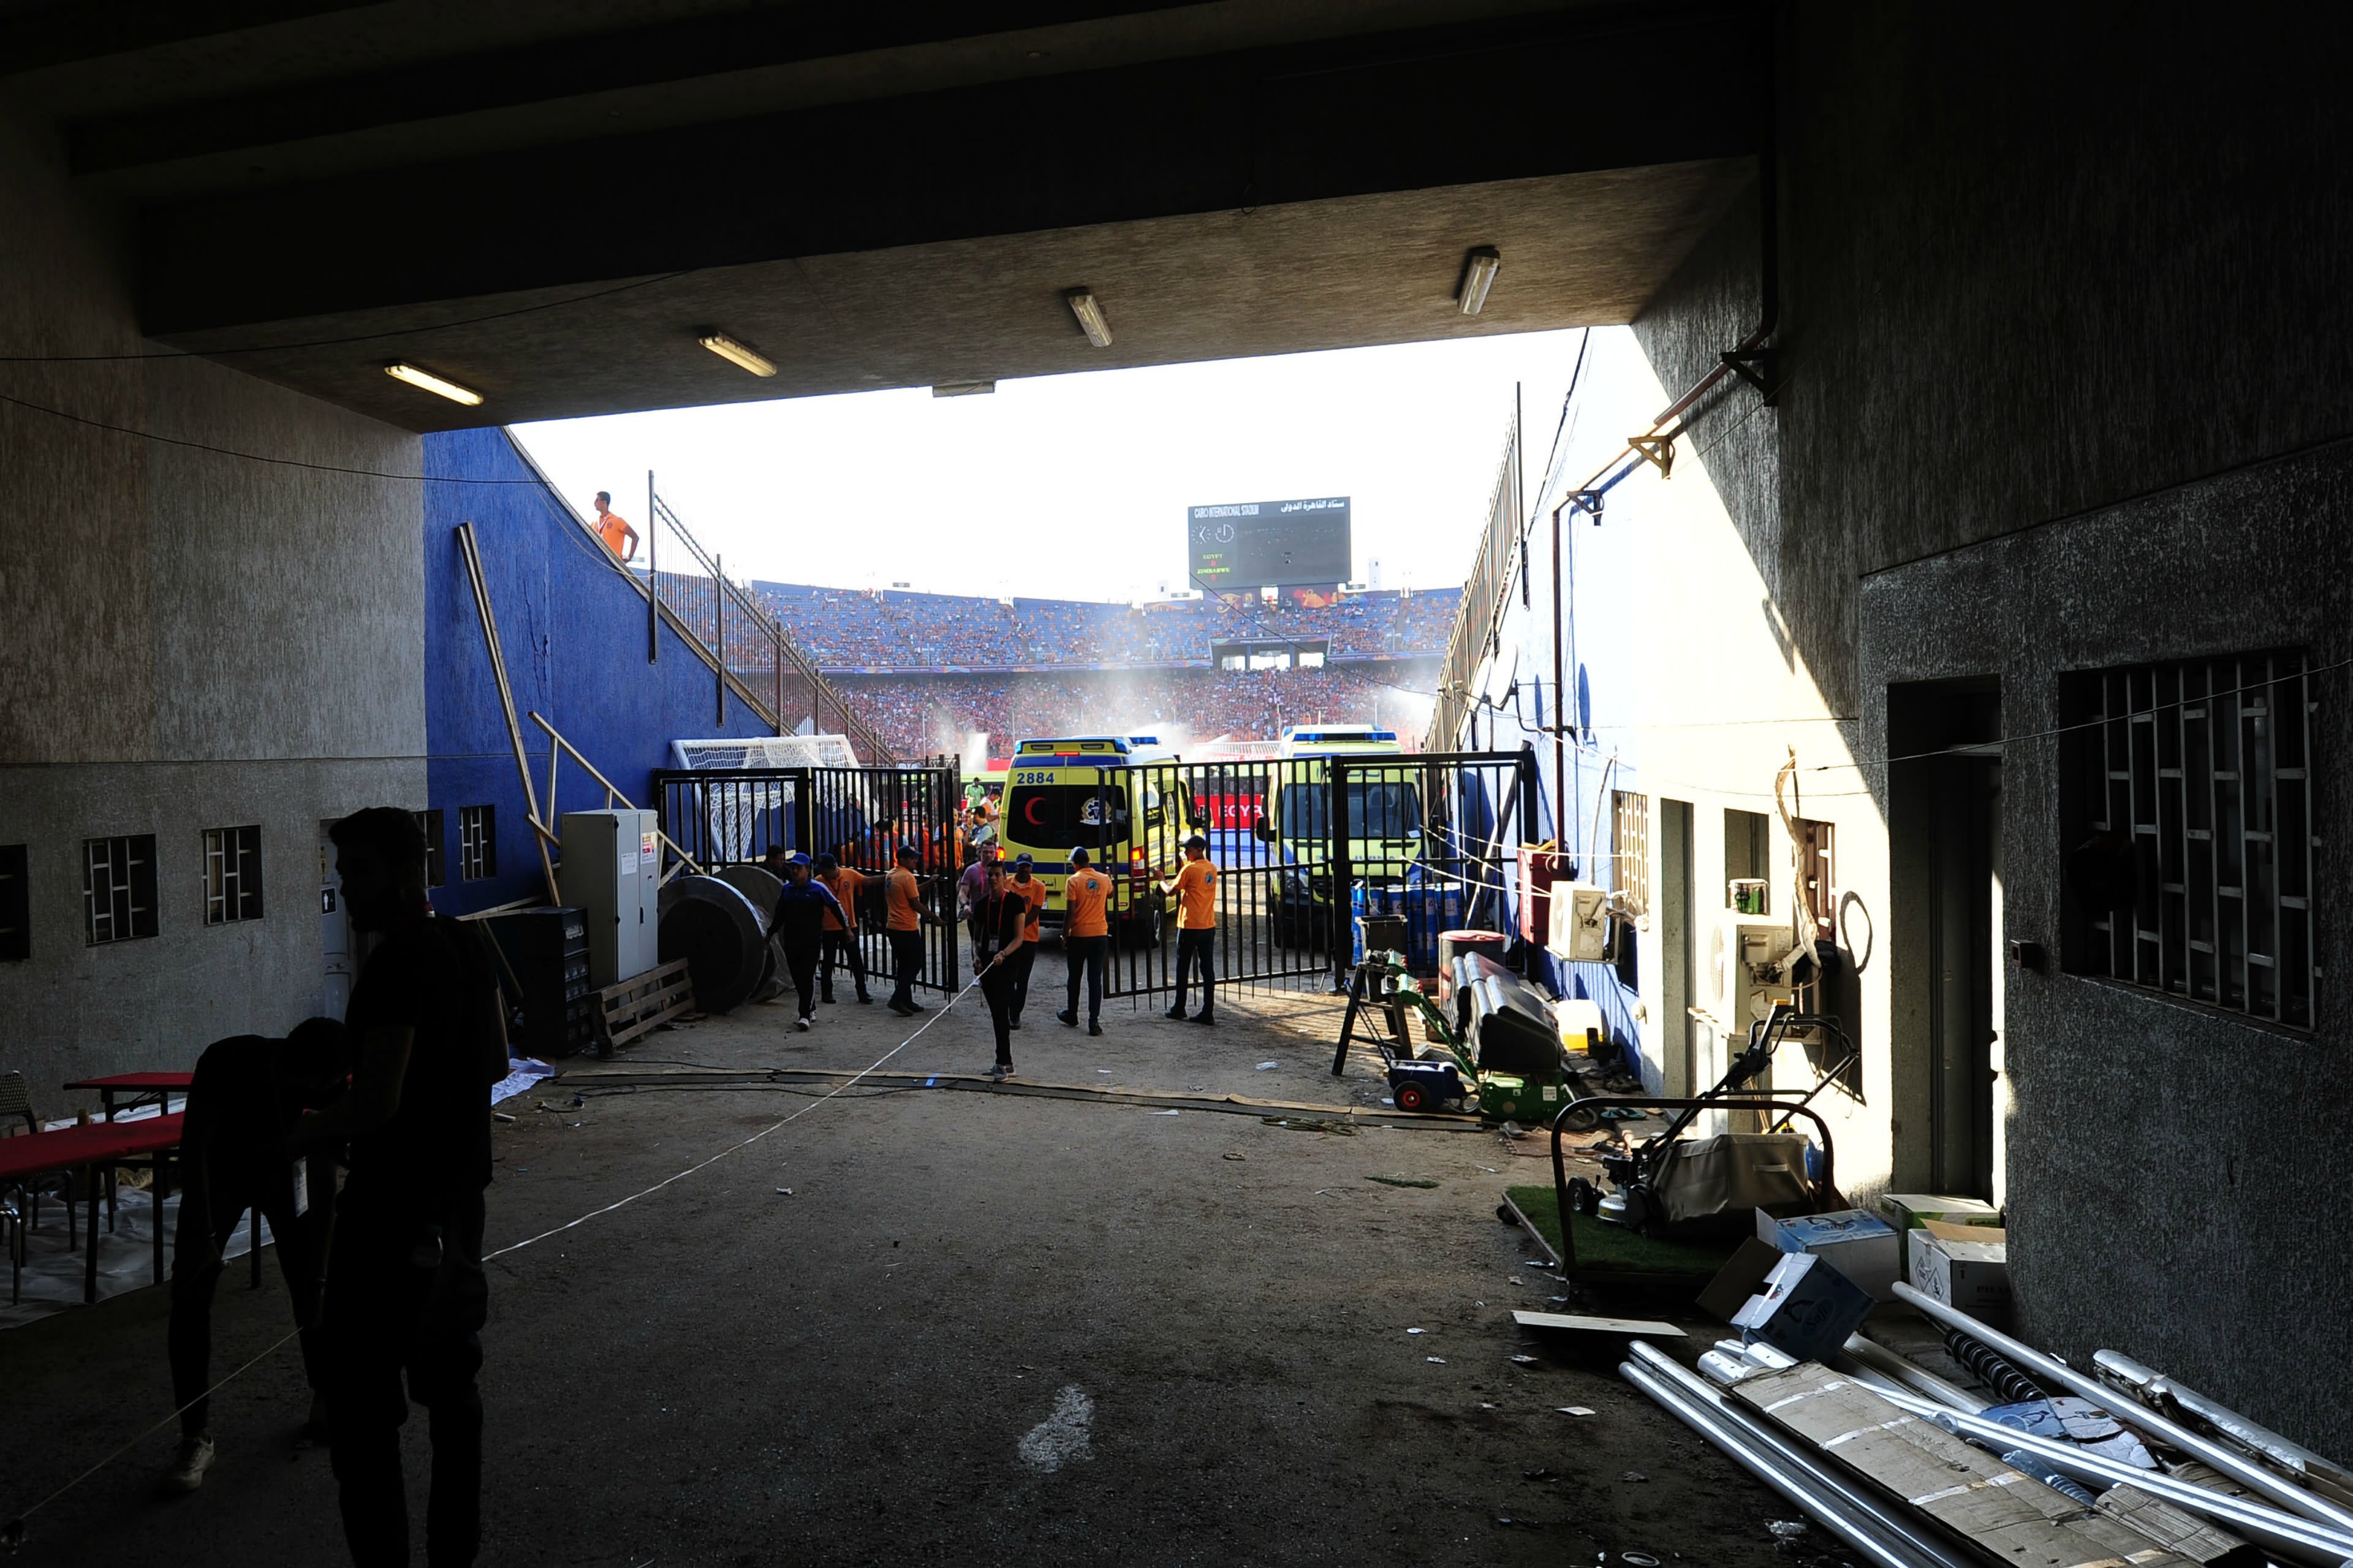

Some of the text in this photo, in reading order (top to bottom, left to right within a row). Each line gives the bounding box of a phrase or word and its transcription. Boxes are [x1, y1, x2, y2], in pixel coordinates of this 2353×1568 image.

[1194, 507, 1209, 519] CAIRO
[1209, 505, 1241, 518] INTERNATIONAL
[1017, 772, 1055, 784] 2884
